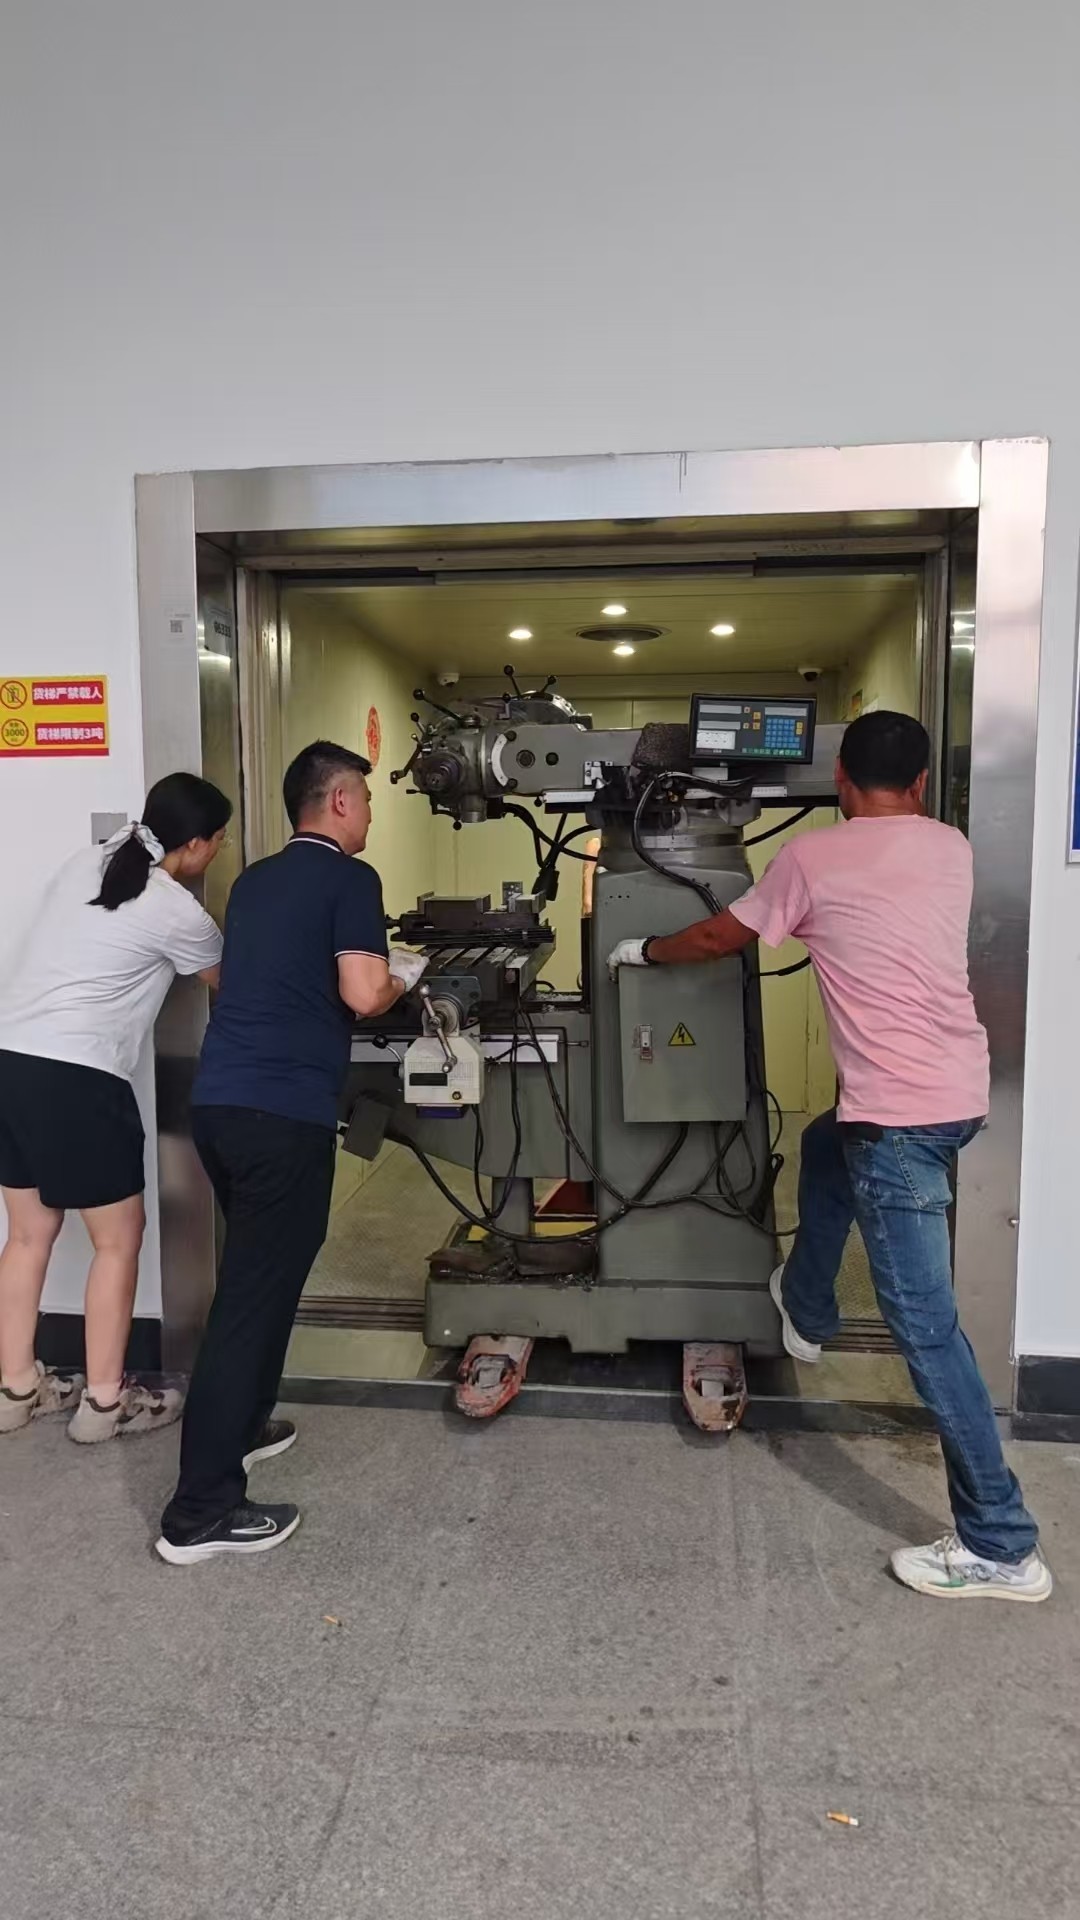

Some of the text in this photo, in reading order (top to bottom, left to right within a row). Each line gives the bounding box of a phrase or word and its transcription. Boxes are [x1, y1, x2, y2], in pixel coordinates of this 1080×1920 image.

[33, 686, 102, 700] 货梯严禁载人
[37, 727, 104, 741] 货梯限制3吨
